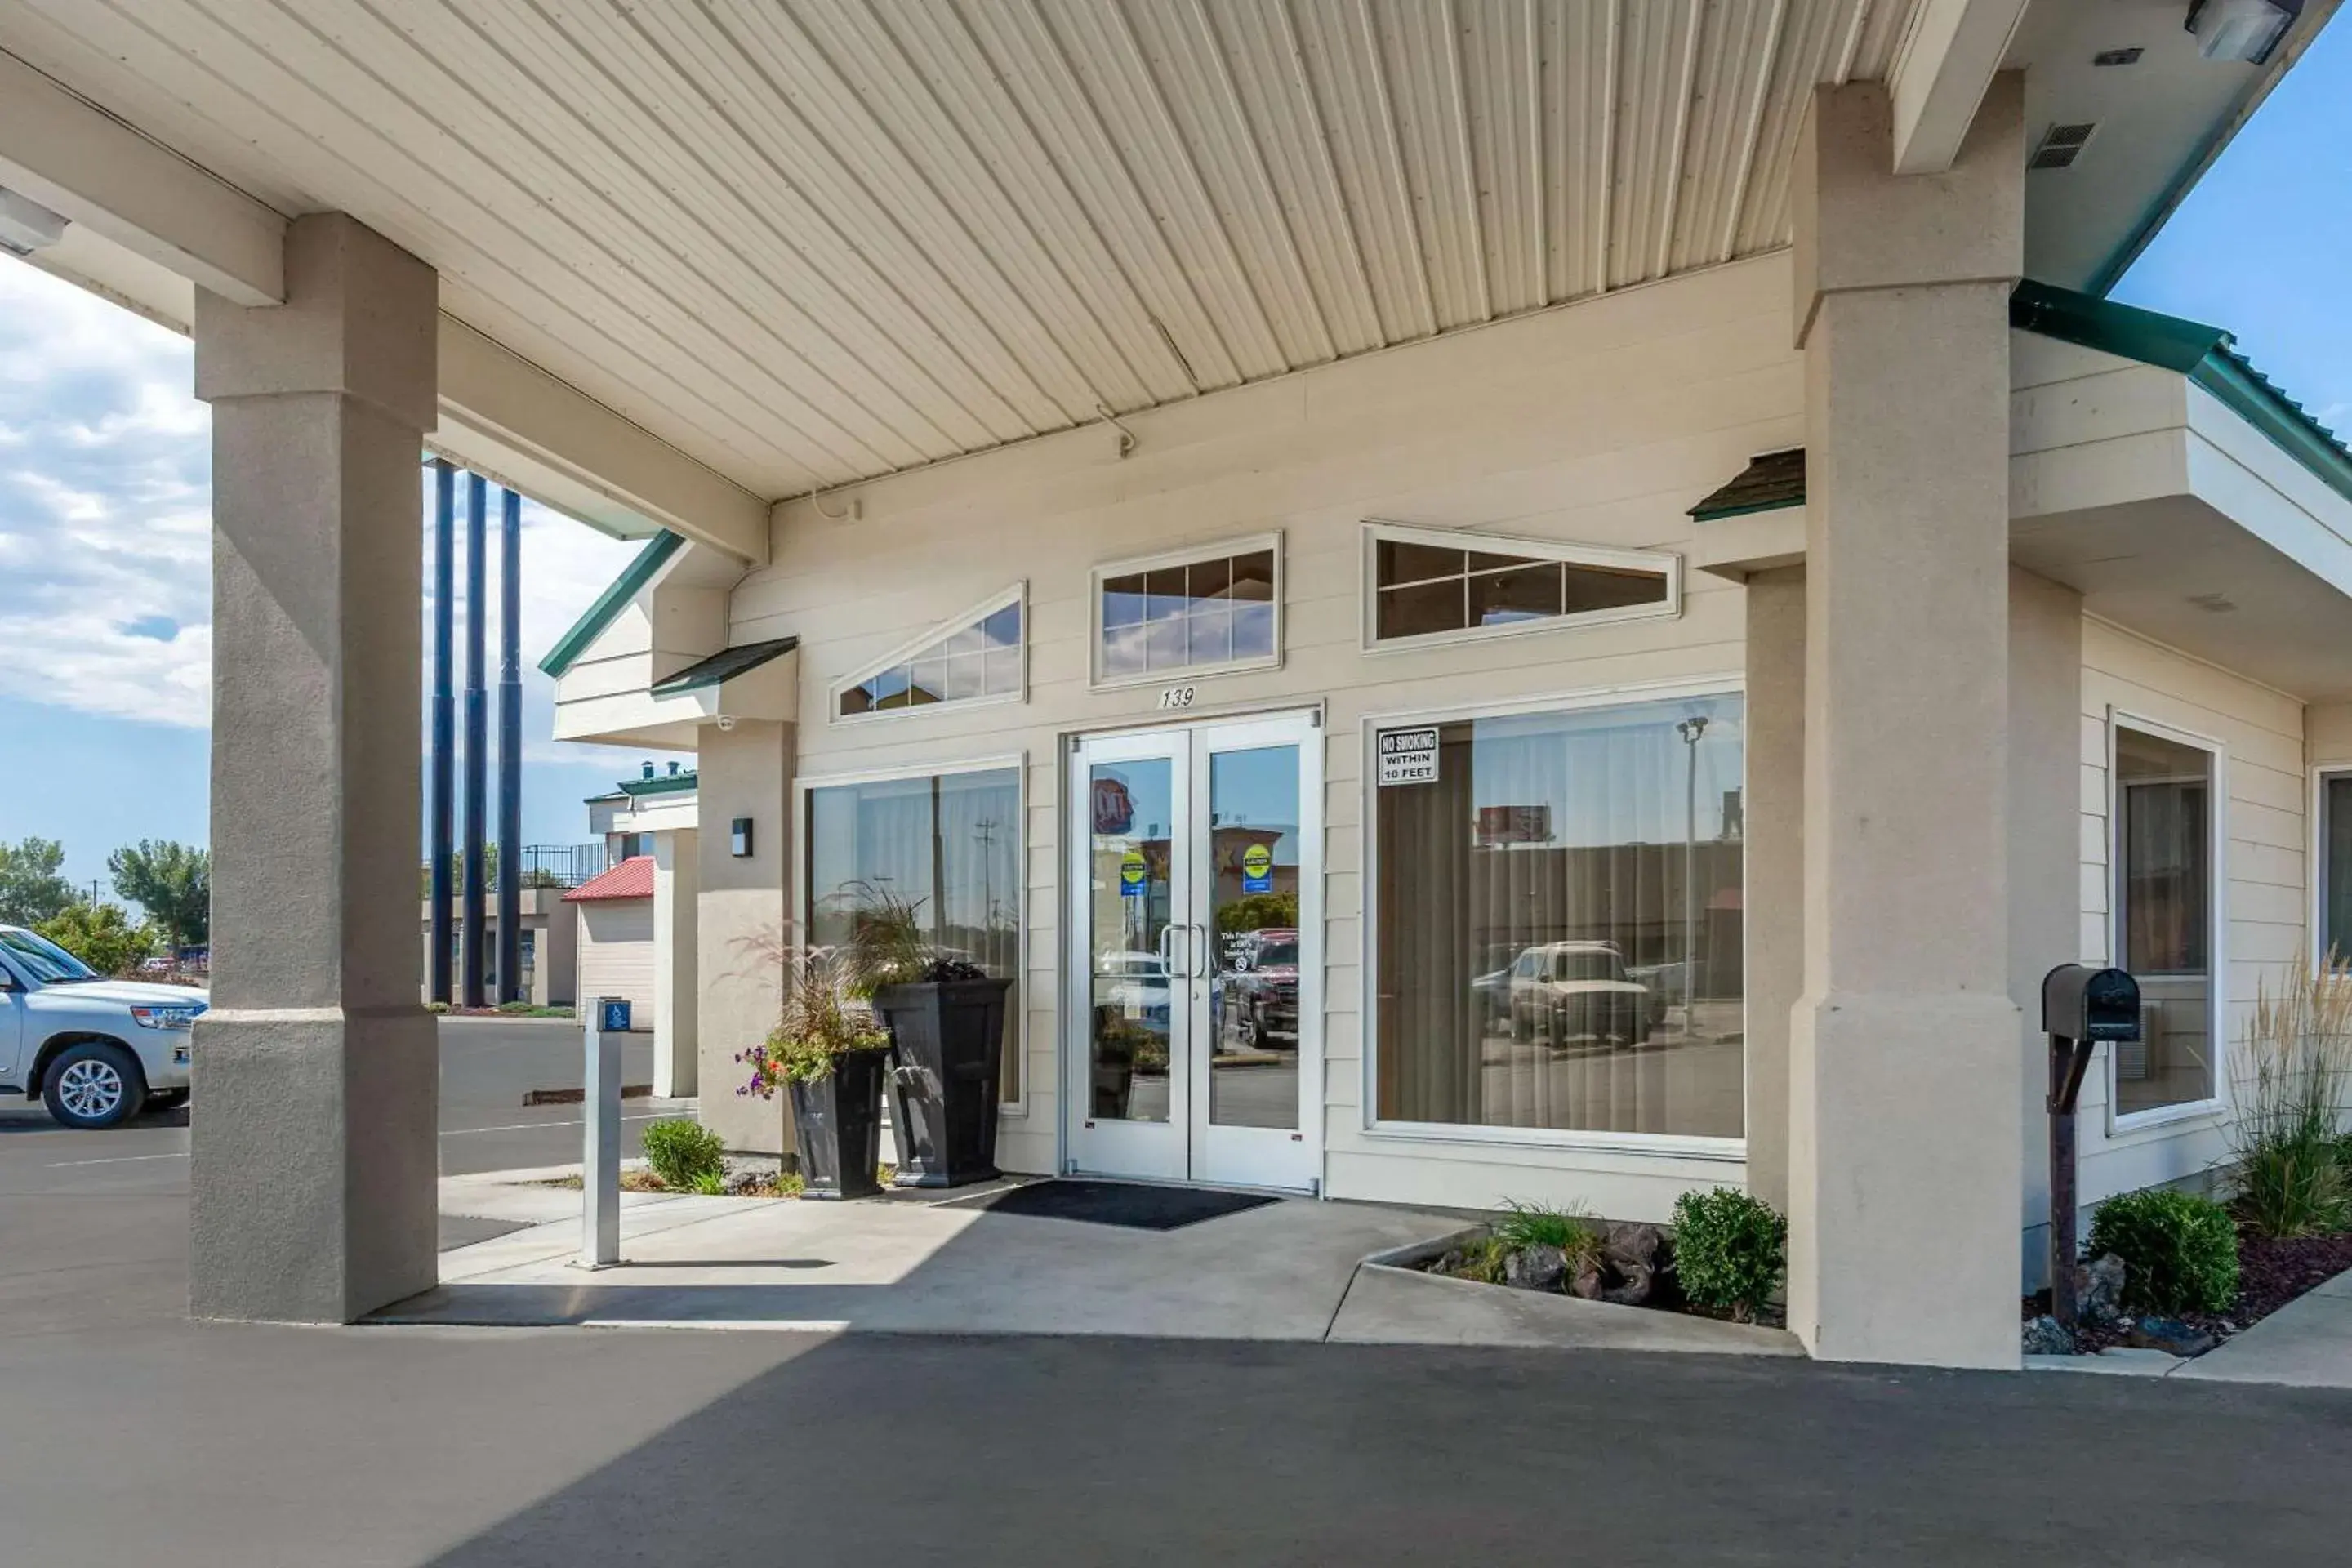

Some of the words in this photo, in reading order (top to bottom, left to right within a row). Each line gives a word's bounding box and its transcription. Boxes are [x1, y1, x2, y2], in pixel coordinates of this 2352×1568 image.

[1163, 688, 1194, 707] 139
[1382, 736, 1395, 752] NO
[1396, 733, 1435, 751] SMOKING
[1386, 753, 1430, 764] WITHIN
[1385, 769, 1398, 778] 10
[1402, 767, 1432, 777] FEET
